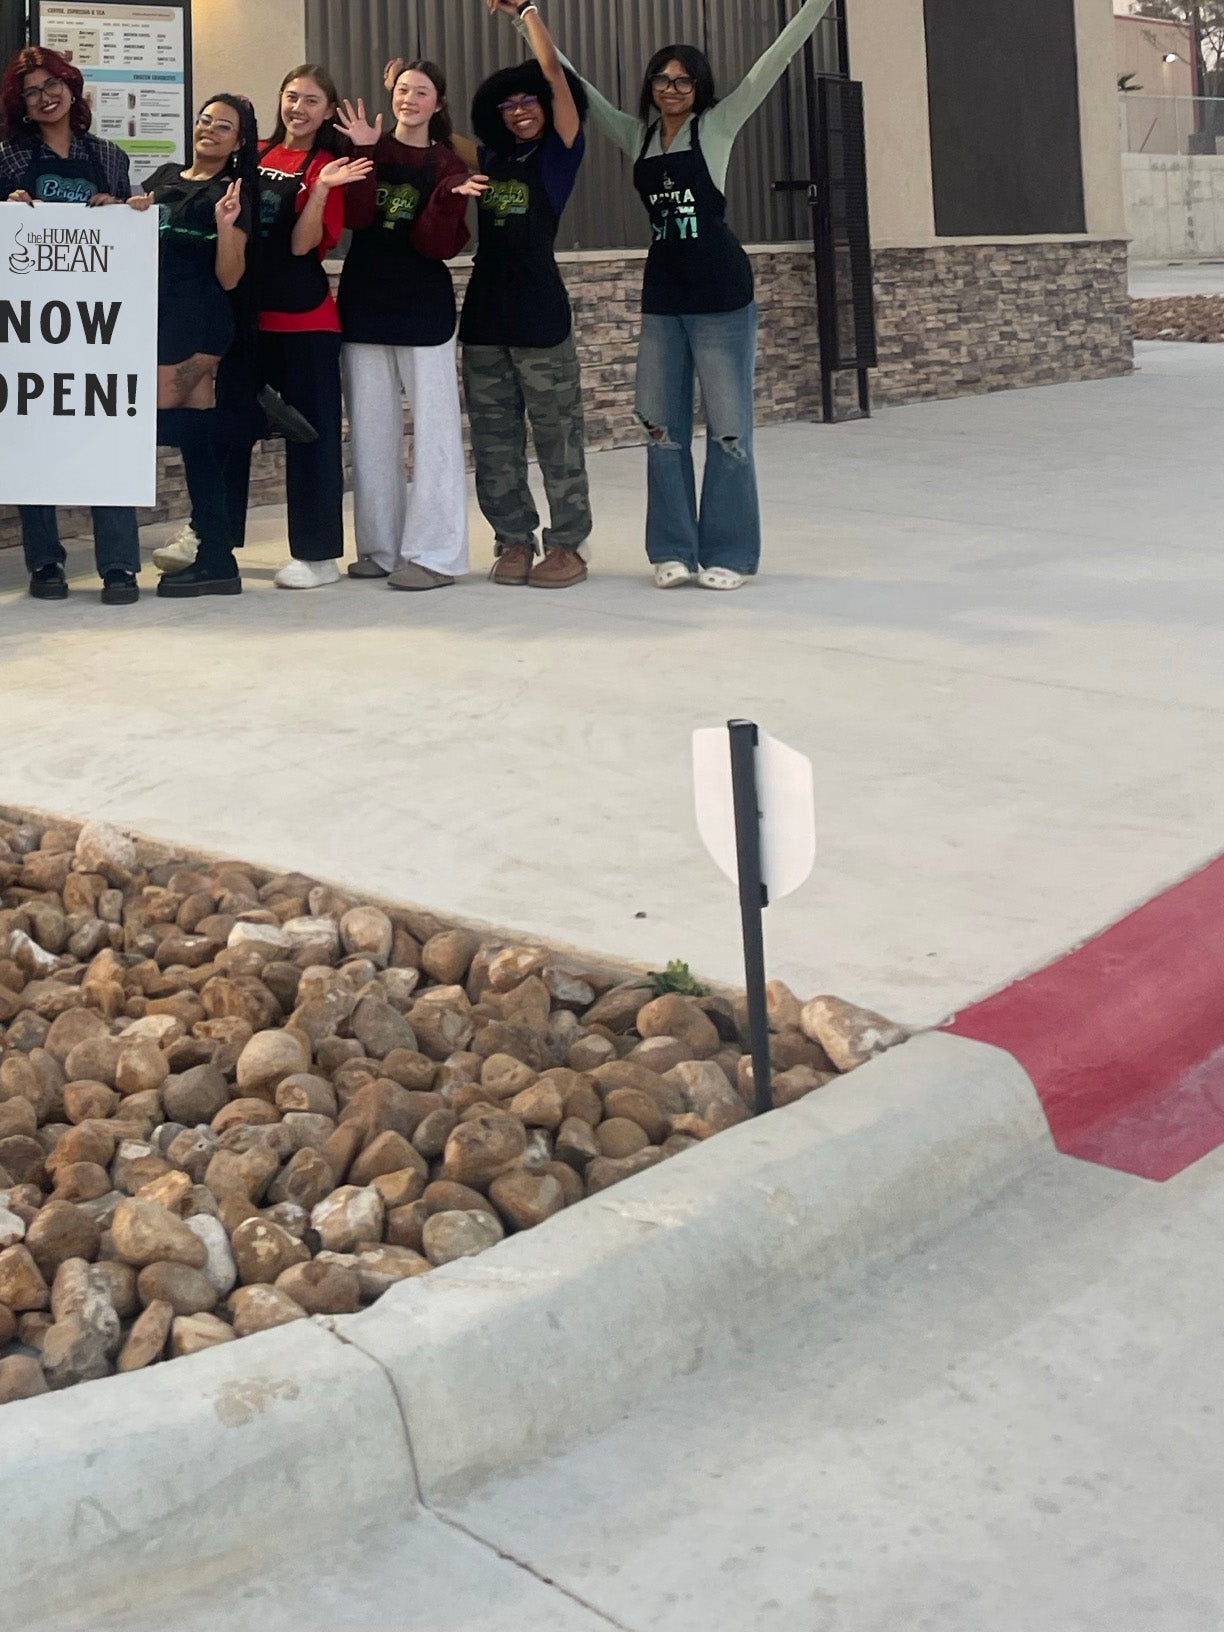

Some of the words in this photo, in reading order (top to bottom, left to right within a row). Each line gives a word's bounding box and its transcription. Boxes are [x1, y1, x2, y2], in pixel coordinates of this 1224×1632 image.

[27, 232, 42, 244] the
[42, 228, 101, 245] HUMAN
[34, 244, 110, 273] BEAN
